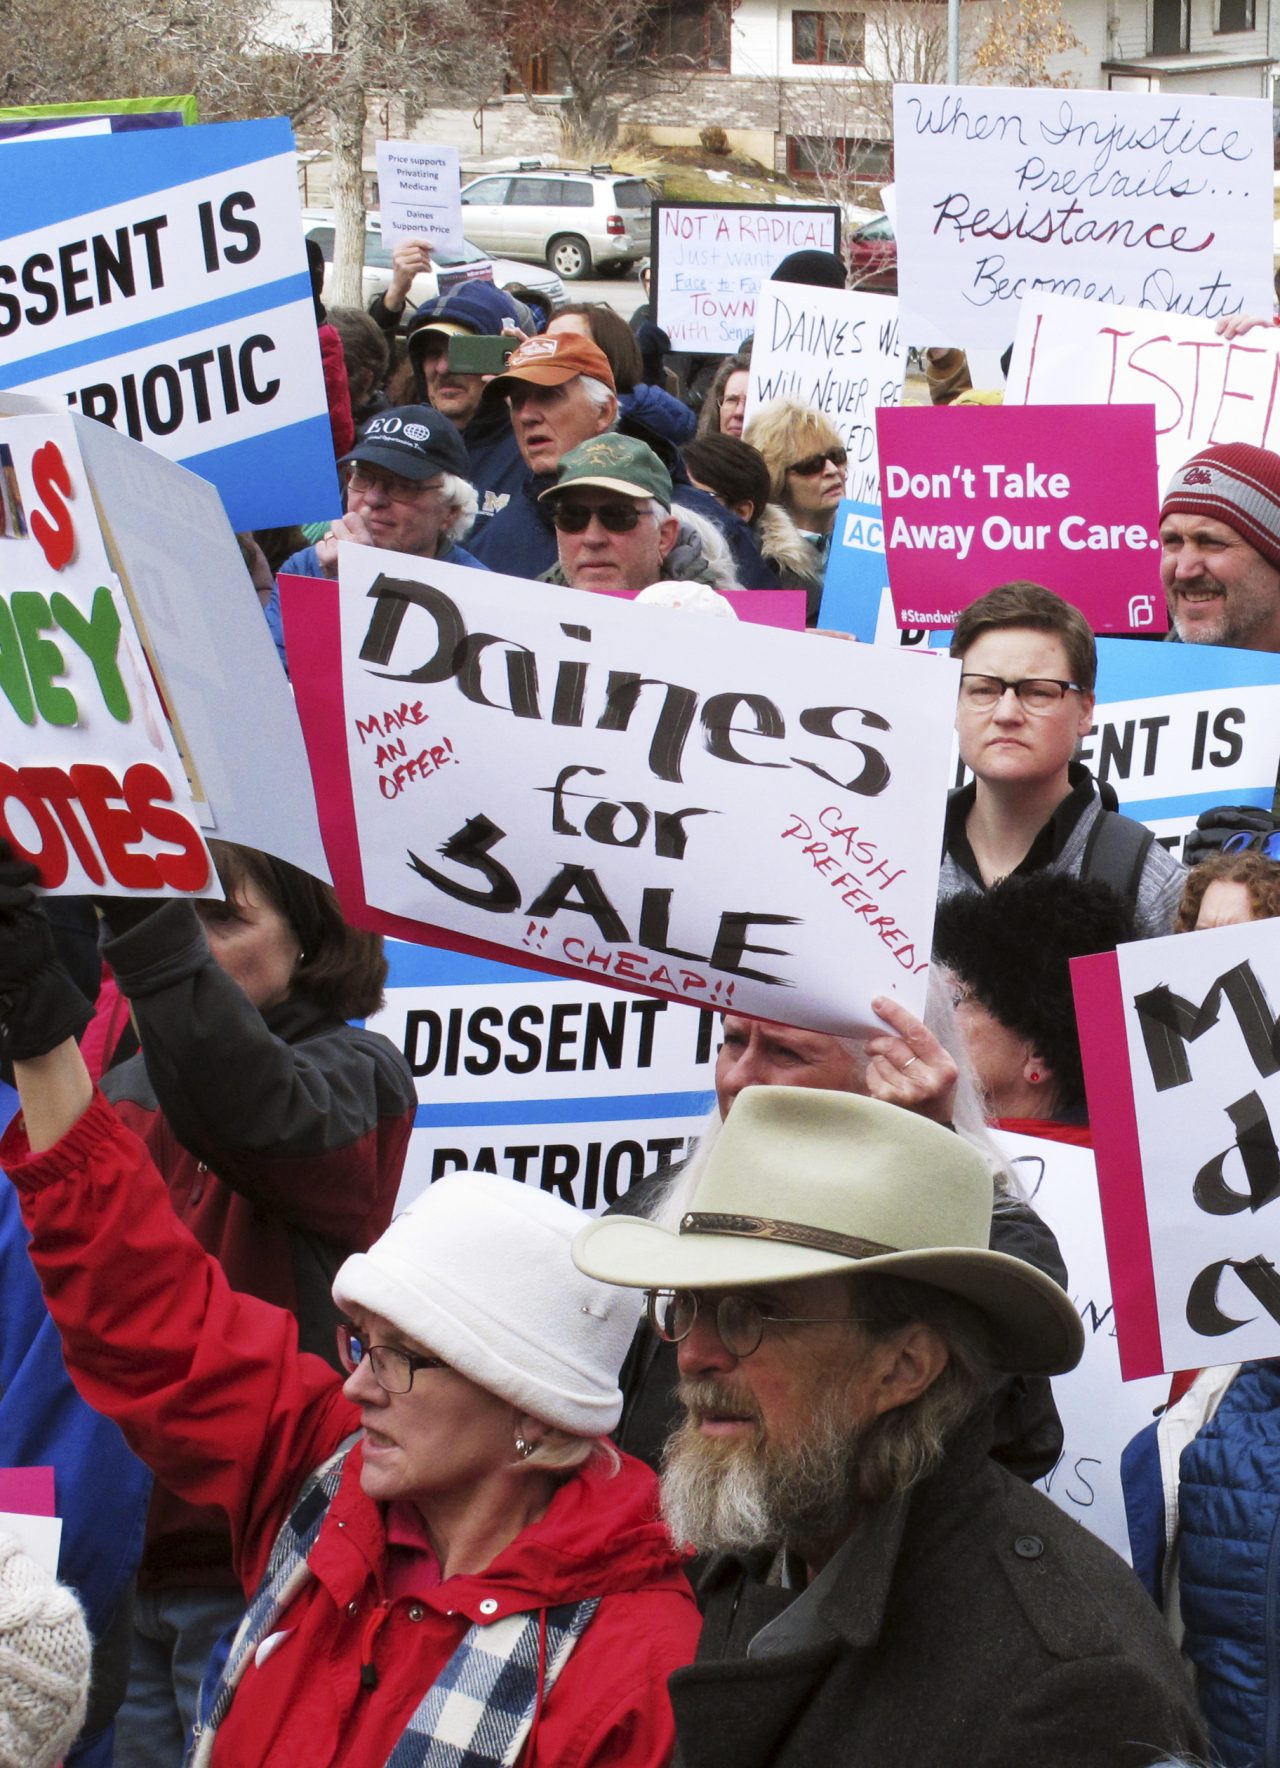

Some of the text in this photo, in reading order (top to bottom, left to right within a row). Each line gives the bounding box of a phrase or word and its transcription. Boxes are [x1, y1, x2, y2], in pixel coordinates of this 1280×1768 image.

[907, 96, 1253, 171] When Injustice
[388, 154, 446, 167] Price supports
[396, 168, 439, 180] Privatizing
[399, 181, 438, 192] Medicare
[198, 190, 261, 273] IS
[392, 221, 450, 234] Supports Price
[406, 210, 434, 220] Daines
[665, 210, 708, 240] NOT
[933, 193, 1215, 252] Resistance
[673, 243, 774, 268] Just want
[690, 292, 755, 318] TOWN
[771, 296, 866, 359] DAINES
[810, 367, 870, 418] NEVER
[365, 417, 402, 435] EO
[982, 463, 1070, 498] Take
[889, 515, 1160, 560] Away Our Care.
[359, 572, 893, 798] Daines
[355, 700, 430, 745] MAKE
[1191, 706, 1246, 771] IS
[374, 737, 408, 769] AN
[378, 736, 461, 800] OFFER!
[532, 764, 726, 861] for
[818, 806, 908, 892] CASH
[404, 812, 807, 989] SALE
[402, 1000, 669, 1078] DISSENT
